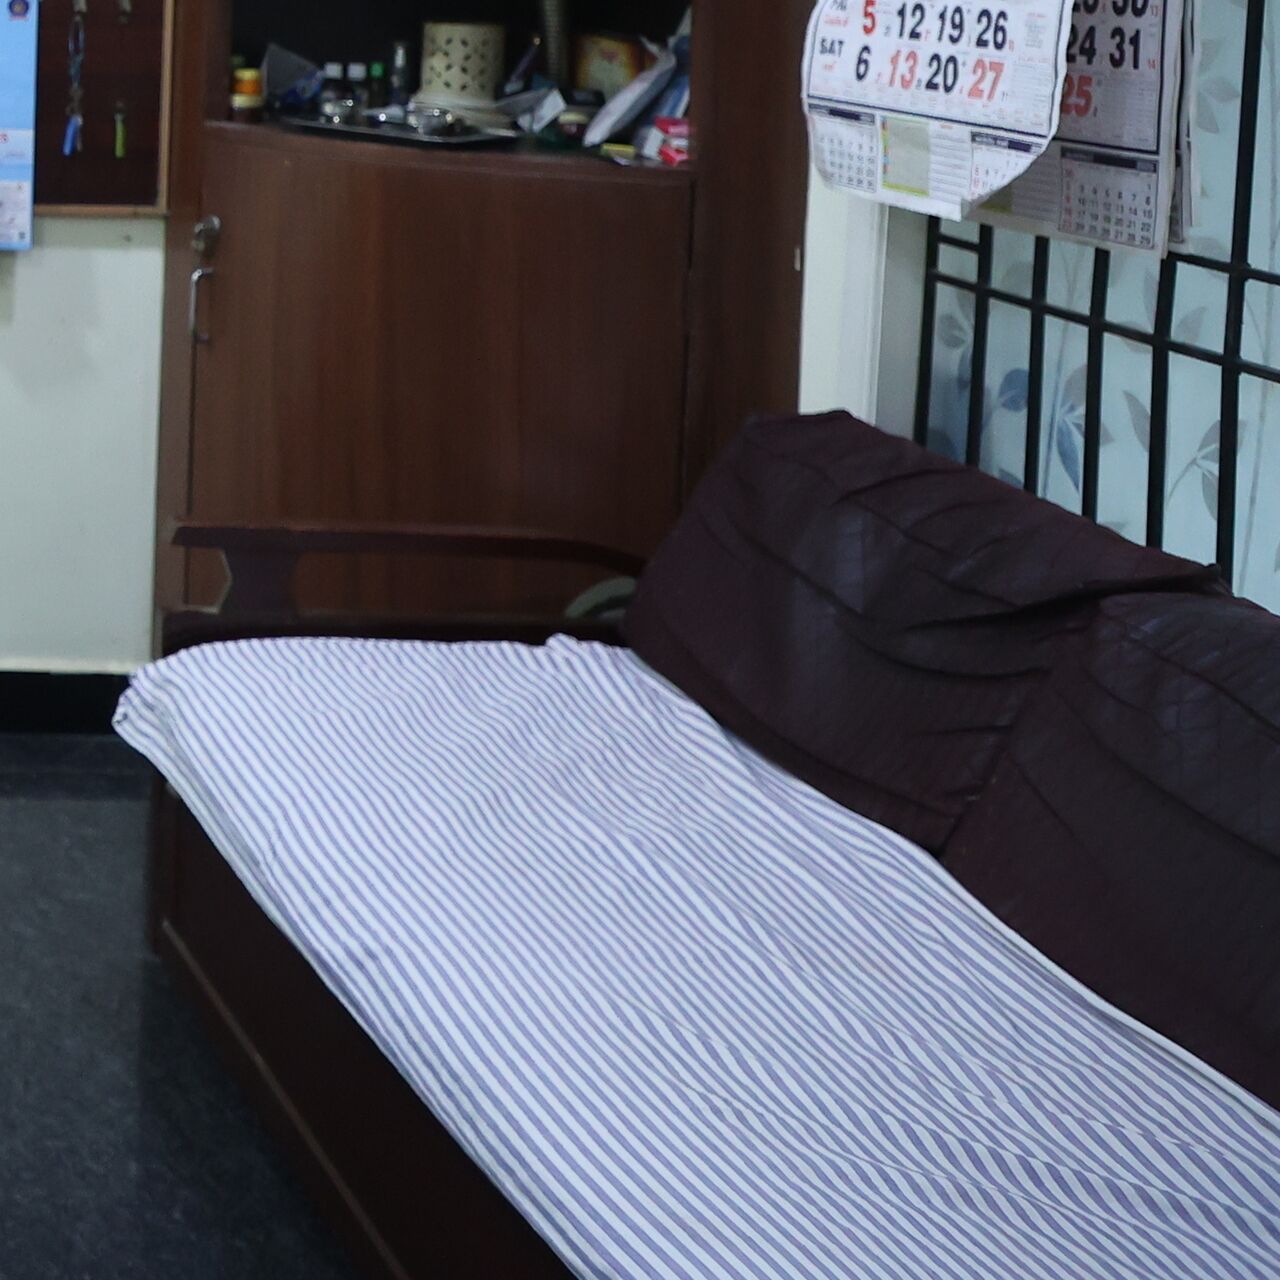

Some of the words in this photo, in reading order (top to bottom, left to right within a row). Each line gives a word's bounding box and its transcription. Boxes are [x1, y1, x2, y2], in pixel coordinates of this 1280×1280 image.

[862, 0, 877, 35] 5
[897, 3, 925, 40] 12
[939, 5, 964, 44] 19
[976, 9, 1008, 50] 26
[819, 36, 845, 55] SAT
[856, 45, 871, 81] 6
[890, 49, 918, 89] 13
[925, 53, 959, 93] 20
[968, 58, 1005, 101] 27
[1109, 27, 1140, 70] 31
[1060, 75, 1094, 118] 25
